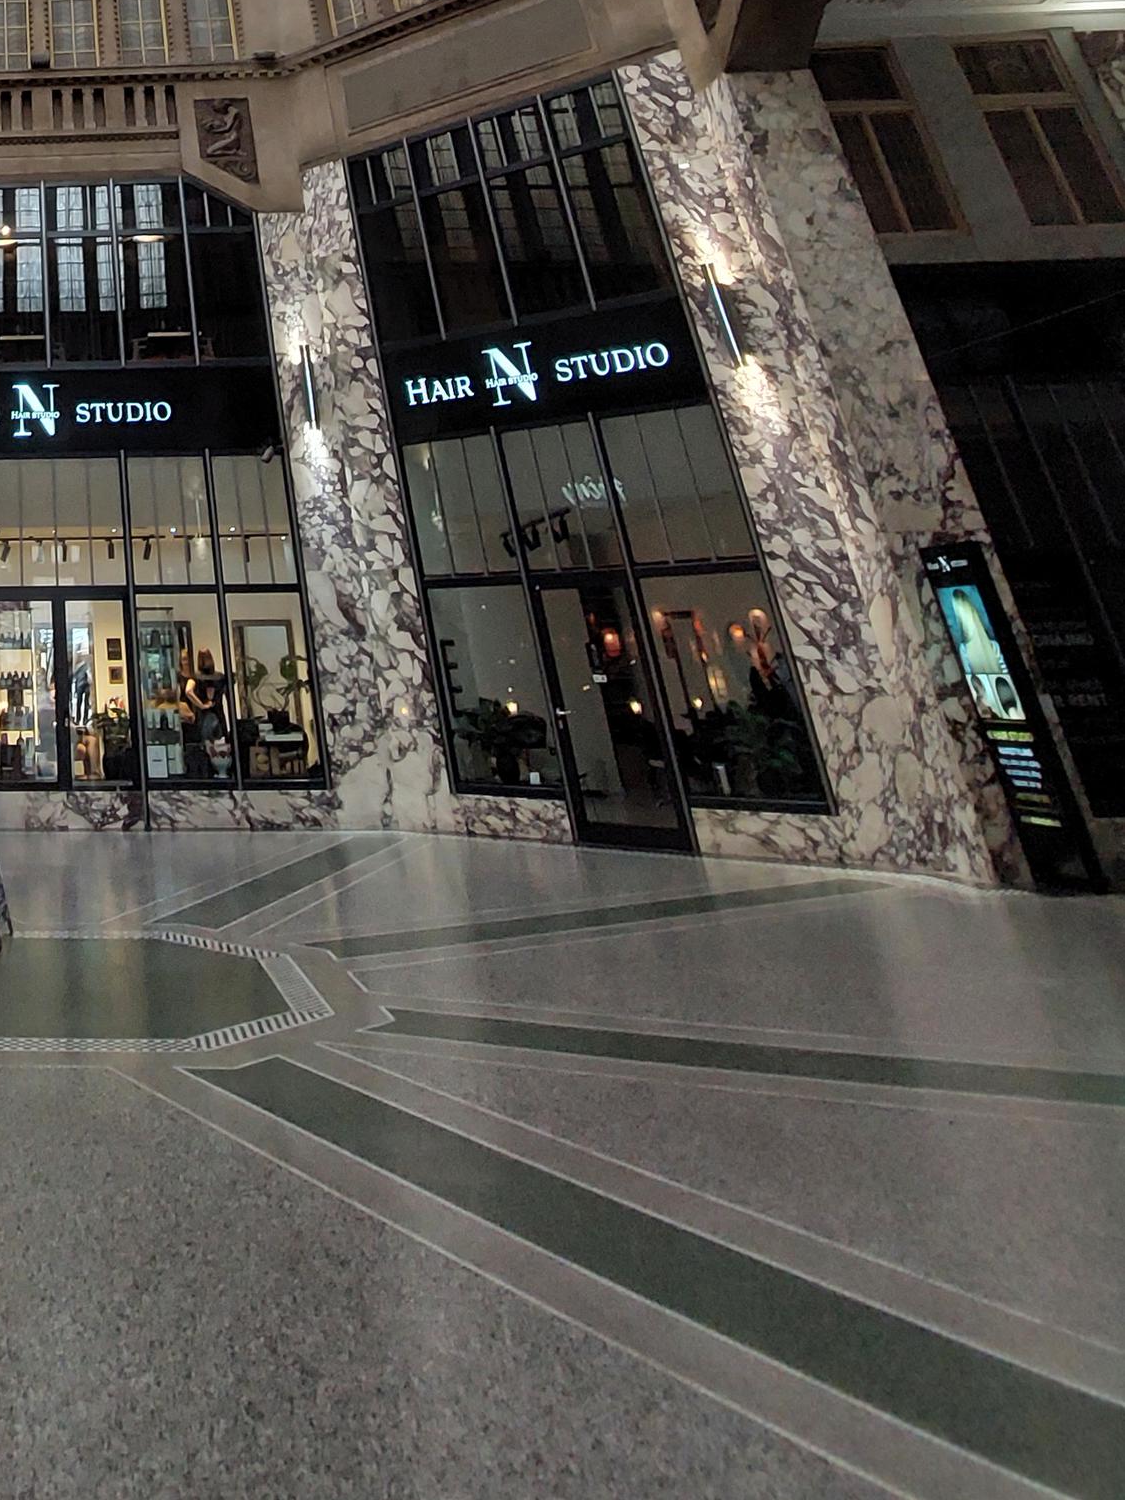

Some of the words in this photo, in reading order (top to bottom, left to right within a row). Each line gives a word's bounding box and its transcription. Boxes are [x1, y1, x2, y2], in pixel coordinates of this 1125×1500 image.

[481, 341, 537, 406] N
[554, 342, 670, 382] STUDIO
[11, 384, 60, 437] N
[75, 401, 172, 423] STUDIO
